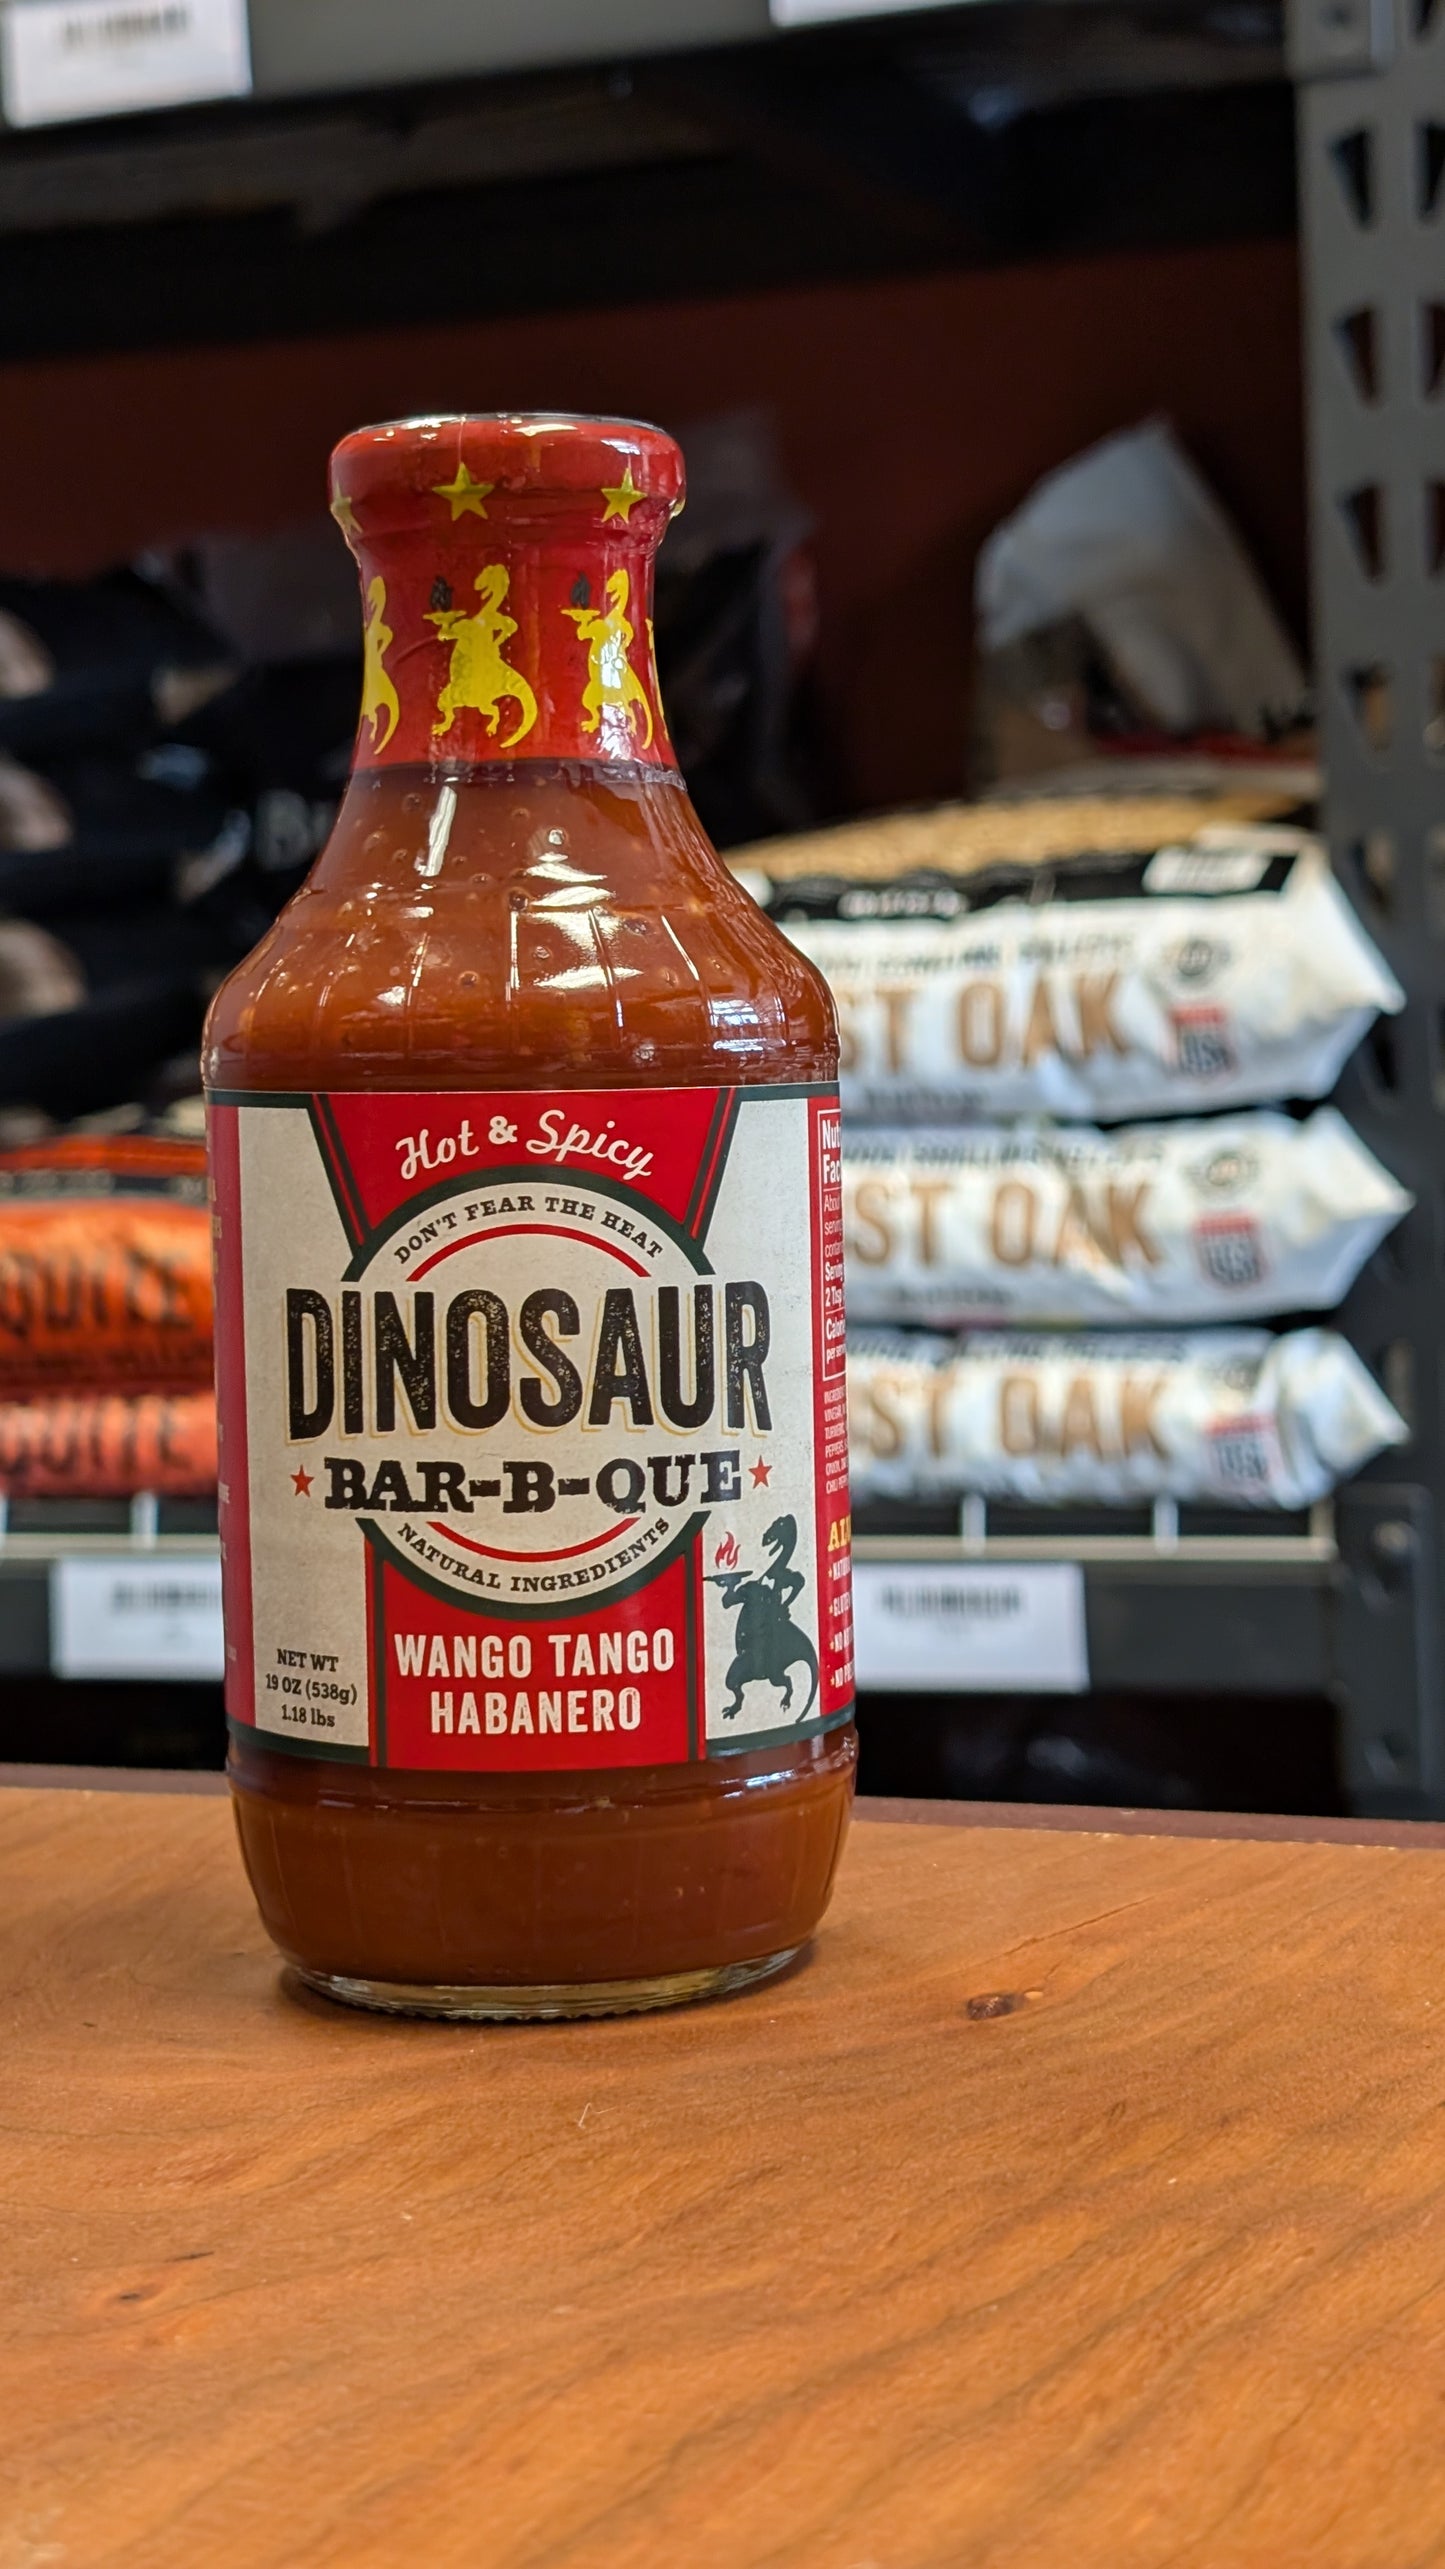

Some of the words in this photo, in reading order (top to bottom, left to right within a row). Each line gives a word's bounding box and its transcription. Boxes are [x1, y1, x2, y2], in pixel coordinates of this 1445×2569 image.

[957, 967, 1135, 1068] OAK
[395, 1119, 480, 1180] Hot
[488, 1115, 518, 1145] &
[525, 1109, 654, 1180] Spicy
[393, 1212, 457, 1264] DON'T
[464, 1195, 536, 1221] FEAR
[544, 1196, 596, 1221] THE
[601, 1211, 664, 1258] HEAT
[990, 1171, 1164, 1267] OAK
[285, 1280, 774, 1441] DINOSAUR
[1000, 1370, 1171, 1461] OAK
[324, 1449, 742, 1514] BAR-B-QUE
[397, 1523, 501, 1590] NATURAL
[510, 1517, 670, 1592] INGREDIENTS
[276, 1648, 307, 1669] NET
[311, 1654, 339, 1672] WT
[394, 1633, 532, 1679] WANGO
[548, 1628, 675, 1677] TANGO
[265, 1673, 279, 1691] 19
[282, 1676, 302, 1695] OZ
[305, 1679, 358, 1706] (538g)
[281, 1704, 307, 1724] 1.18
[311, 1708, 336, 1728] lbs
[430, 1686, 641, 1735] HABANERO
